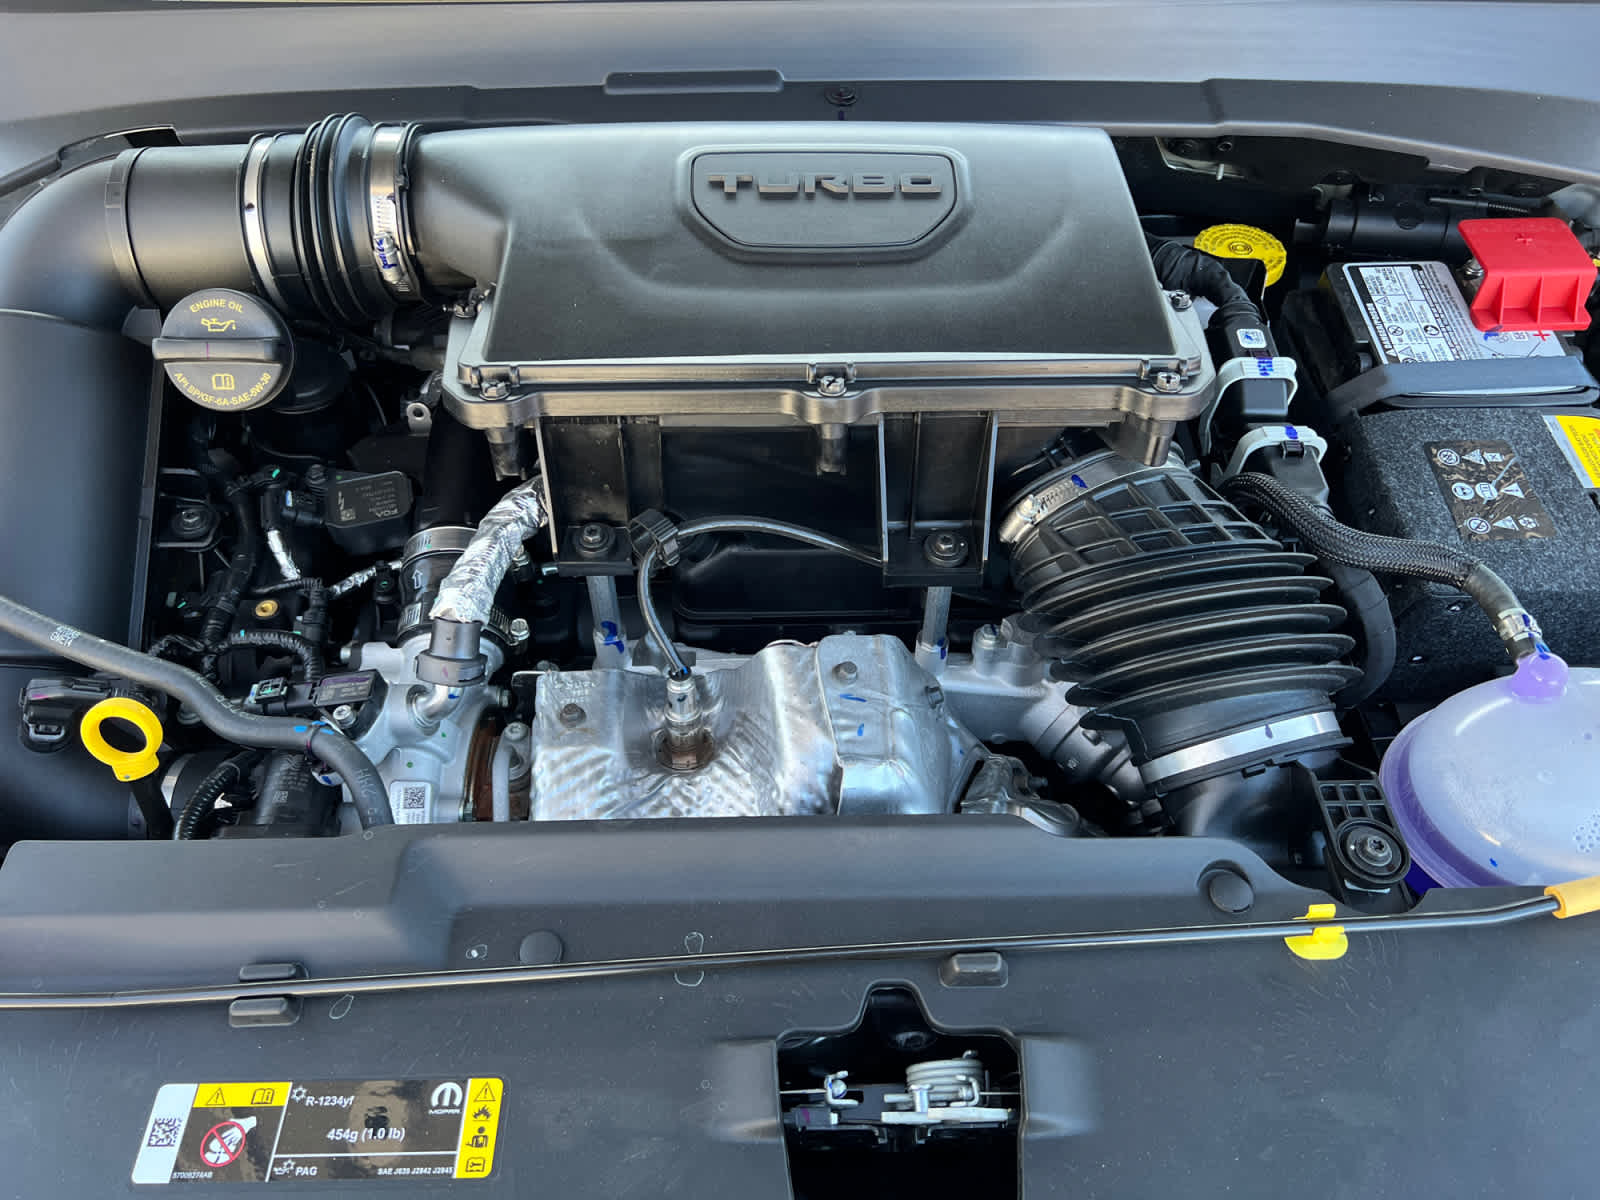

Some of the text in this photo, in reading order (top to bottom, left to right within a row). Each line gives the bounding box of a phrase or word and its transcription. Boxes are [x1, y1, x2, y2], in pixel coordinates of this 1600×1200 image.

[707, 174, 942, 195] TURBO
[189, 299, 244, 314] ENGINE OIL
[305, 1095, 355, 1109] R-1234yf
[326, 1127, 406, 1143] 454g (1.0 lb)
[294, 1166, 318, 1177] PAG
